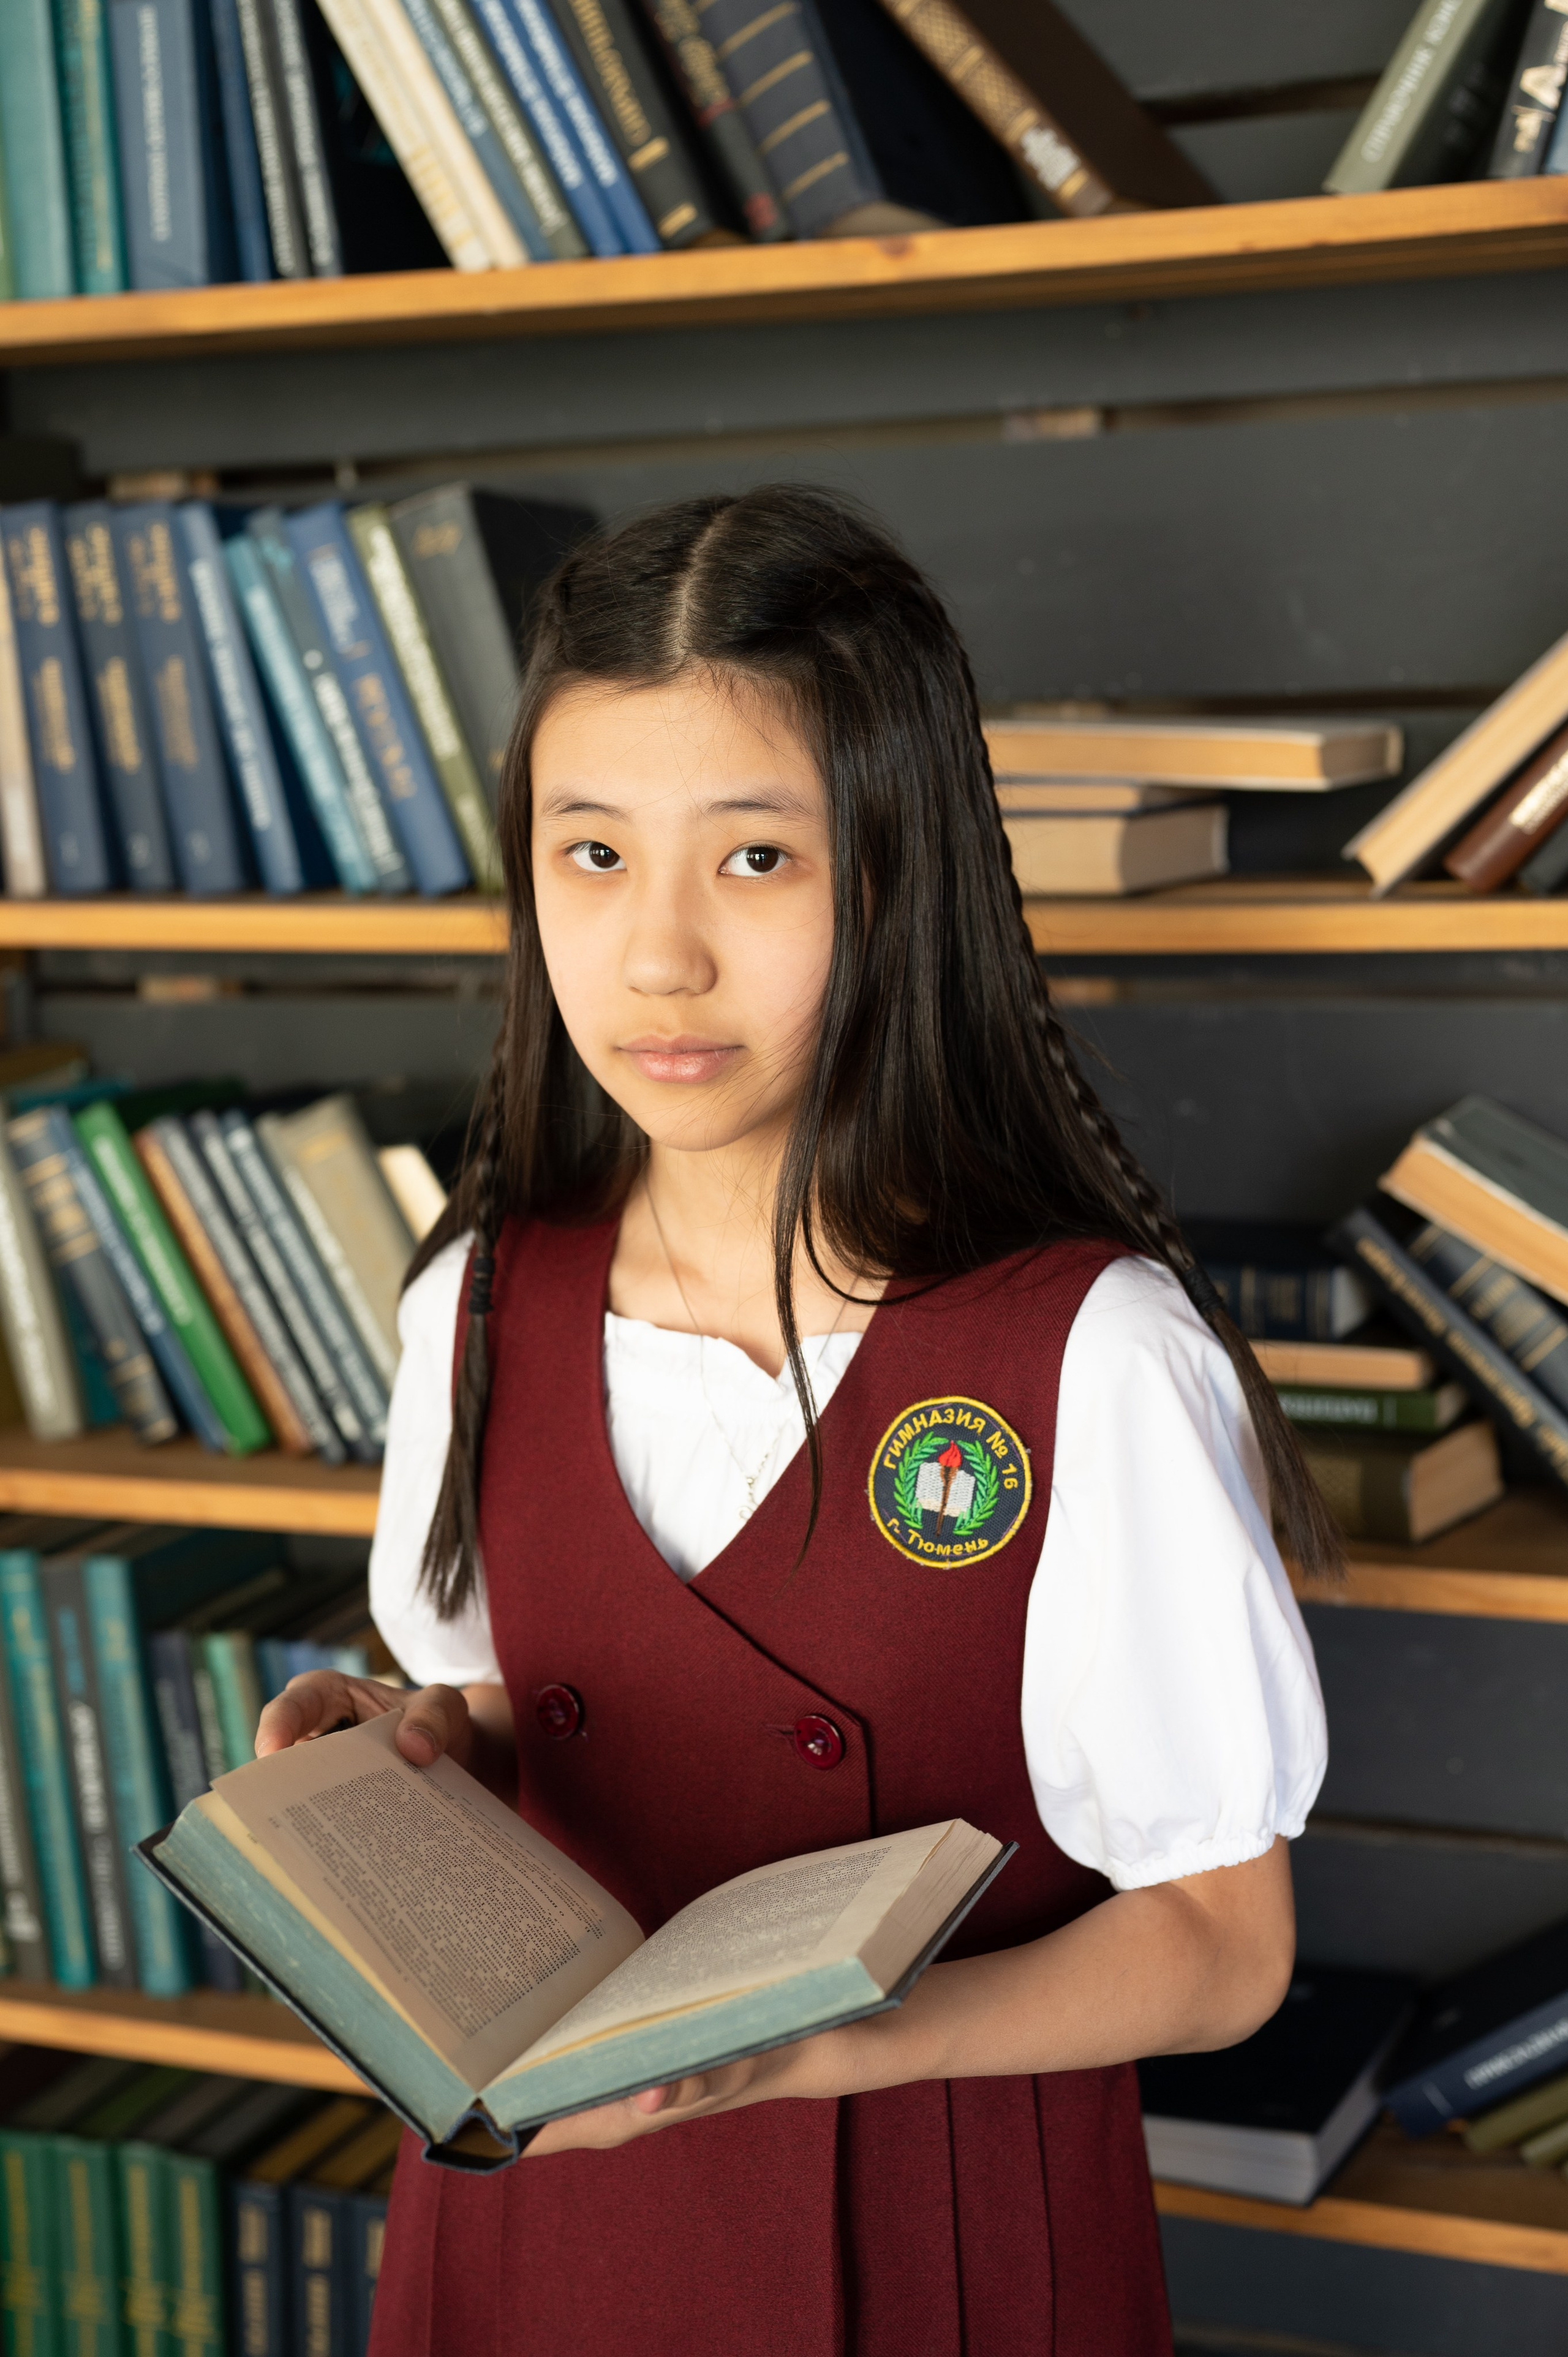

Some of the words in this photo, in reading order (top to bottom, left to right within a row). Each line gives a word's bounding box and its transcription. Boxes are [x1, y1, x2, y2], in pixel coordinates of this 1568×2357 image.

[883, 1408, 986, 1469] ГИМНАЗИЯ
[1001, 1463, 1018, 1490] 16
[908, 1529, 989, 1555] Тюмень
